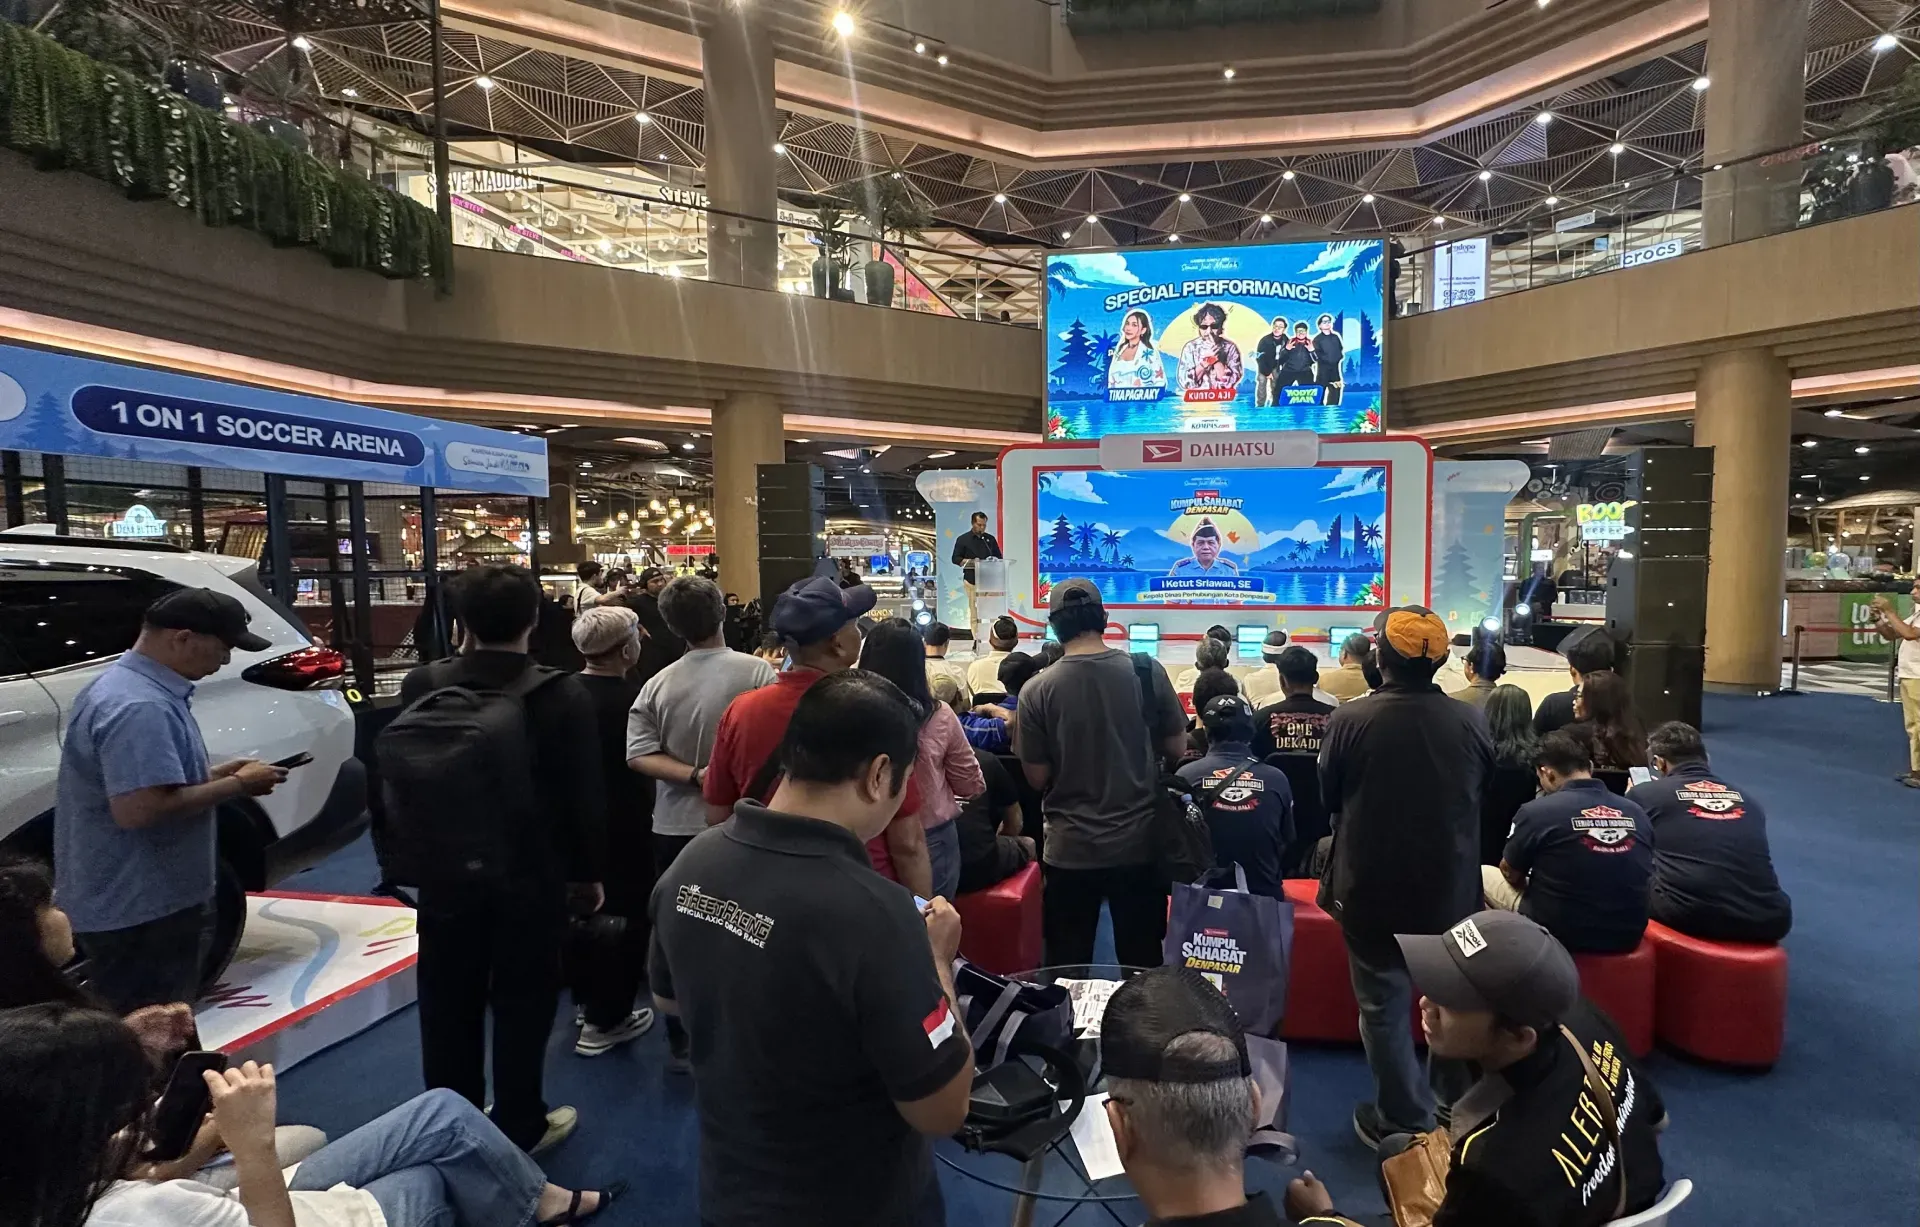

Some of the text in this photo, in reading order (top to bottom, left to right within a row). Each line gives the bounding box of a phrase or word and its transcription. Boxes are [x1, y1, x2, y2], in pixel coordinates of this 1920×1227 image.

[427, 171, 470, 194] SVE
[1622, 242, 1677, 265] crocs
[1104, 279, 1321, 312] SPECIAL PERFORMANCE
[1108, 388, 1160, 401] TIKA PAGRAKY
[1188, 391, 1231, 400] KUNTO AJI
[111, 401, 405, 457] 1 ON 1 SOCCER ARENA
[1190, 442, 1275, 458] DAIHATSU
[1170, 496, 1244, 510] KUMPUL SAHABAT
[1185, 506, 1229, 514] DENPASAR
[1166, 579, 1194, 588] Ketut
[1238, 580, 1252, 589] SE
[1182, 591, 1224, 599] Perhubungan
[1286, 722, 1313, 736] ONE
[676, 885, 773, 941] STREET RACING
[676, 904, 704, 920] OFFICIAL
[724, 921, 743, 937] DRAG
[743, 932, 766, 949] RACE
[1193, 932, 1239, 951] KUMPUL
[1181, 941, 1247, 965] SAHABAT
[1185, 956, 1242, 974] DENPASAR
[1616, 1067, 1635, 1136] nlimited
